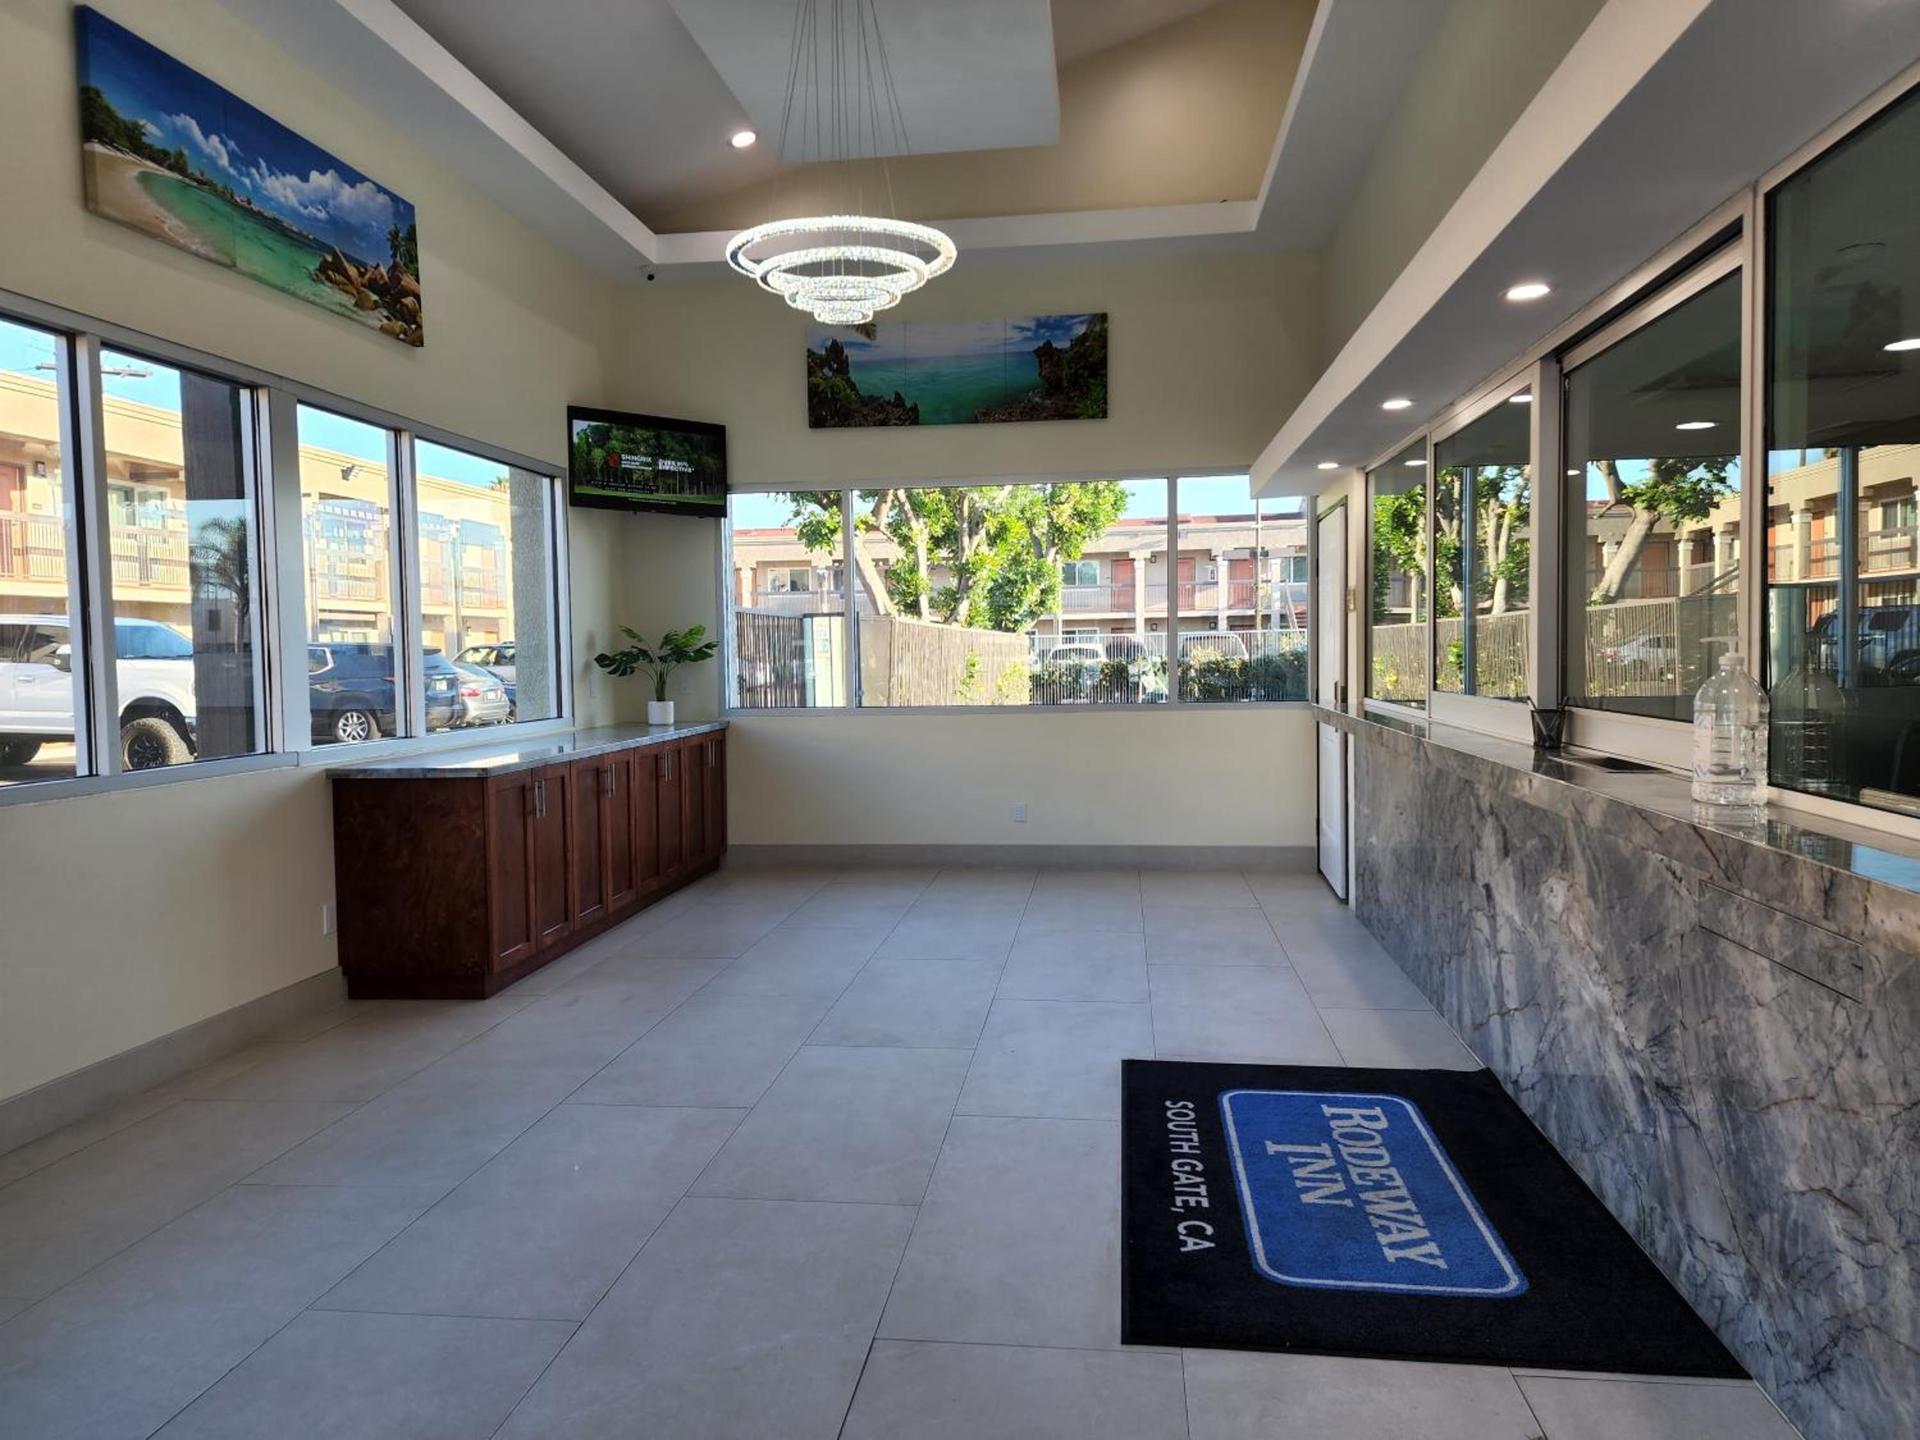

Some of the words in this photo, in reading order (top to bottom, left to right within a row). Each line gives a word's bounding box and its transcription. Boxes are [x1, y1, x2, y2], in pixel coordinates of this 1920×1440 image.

[1165, 1099, 1200, 1156] SOUTH
[1169, 1158, 1210, 1212] GATE,
[1265, 1140, 1354, 1209] INN
[1321, 1103, 1449, 1270] RODEWAY
[1177, 1220, 1216, 1252] CA
